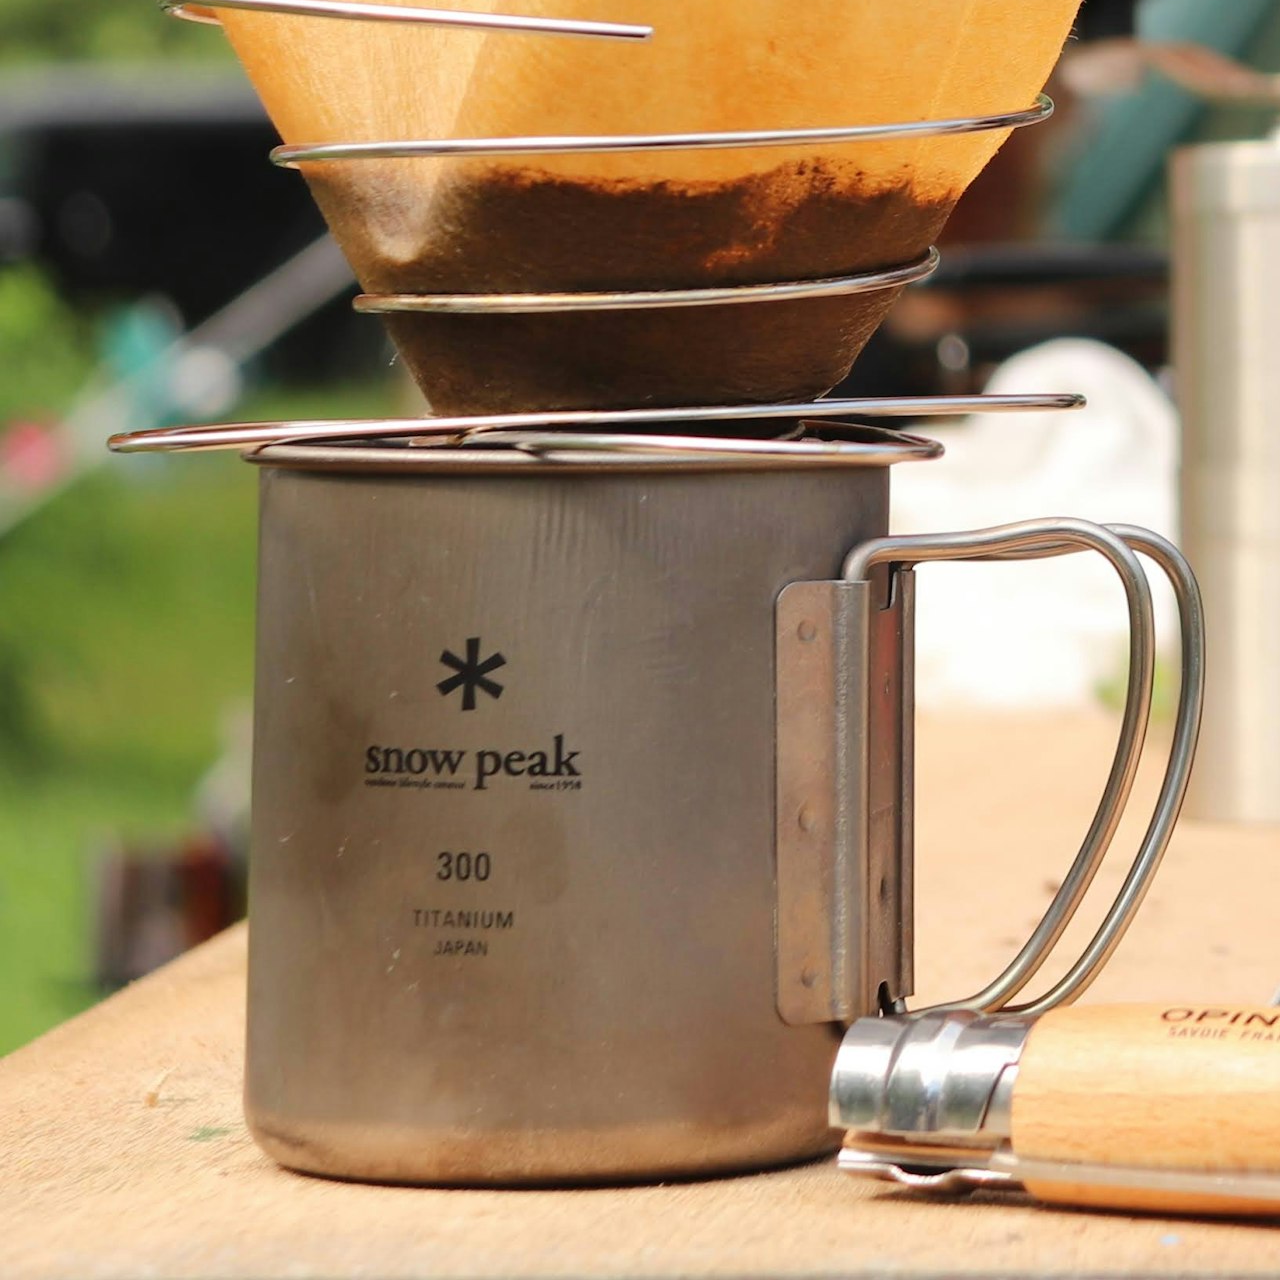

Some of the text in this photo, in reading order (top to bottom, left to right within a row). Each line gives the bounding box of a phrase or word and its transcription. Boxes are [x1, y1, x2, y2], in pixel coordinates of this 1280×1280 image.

[365, 734, 582, 790] snow peak
[436, 851, 491, 881] 300
[412, 909, 514, 928] TITANIUM
[433, 940, 488, 956] JAPAN
[1168, 1025, 1230, 1039] SAVOIE
